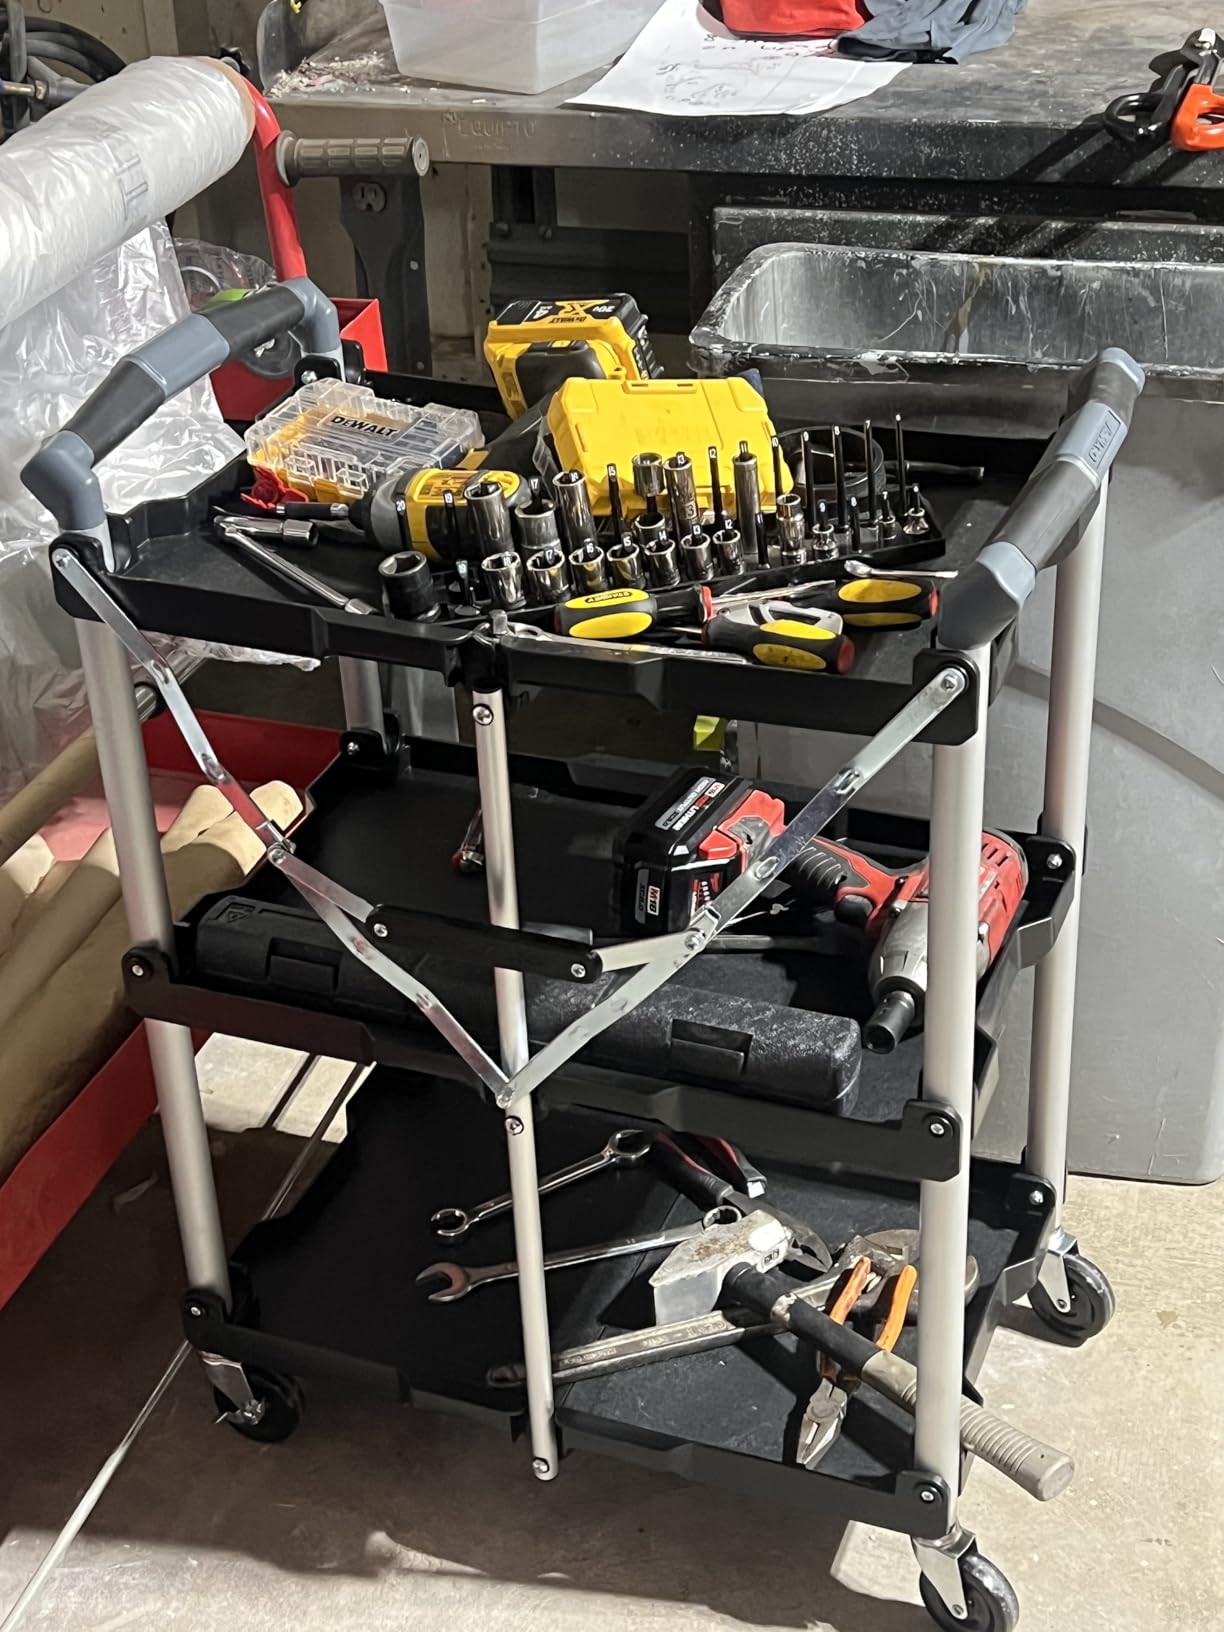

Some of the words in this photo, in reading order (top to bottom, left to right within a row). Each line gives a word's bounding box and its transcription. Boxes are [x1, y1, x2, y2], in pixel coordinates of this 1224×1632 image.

[331, 416, 398, 437] DEWALT
[864, 419, 871, 430] 7
[740, 443, 748, 454] 11
[530, 479, 539, 490] 17
[882, 491, 889, 500] 7
[395, 500, 406, 512] 20
[724, 520, 733, 530] 12
[544, 550, 554, 561] 17
[650, 887, 659, 914] M18
